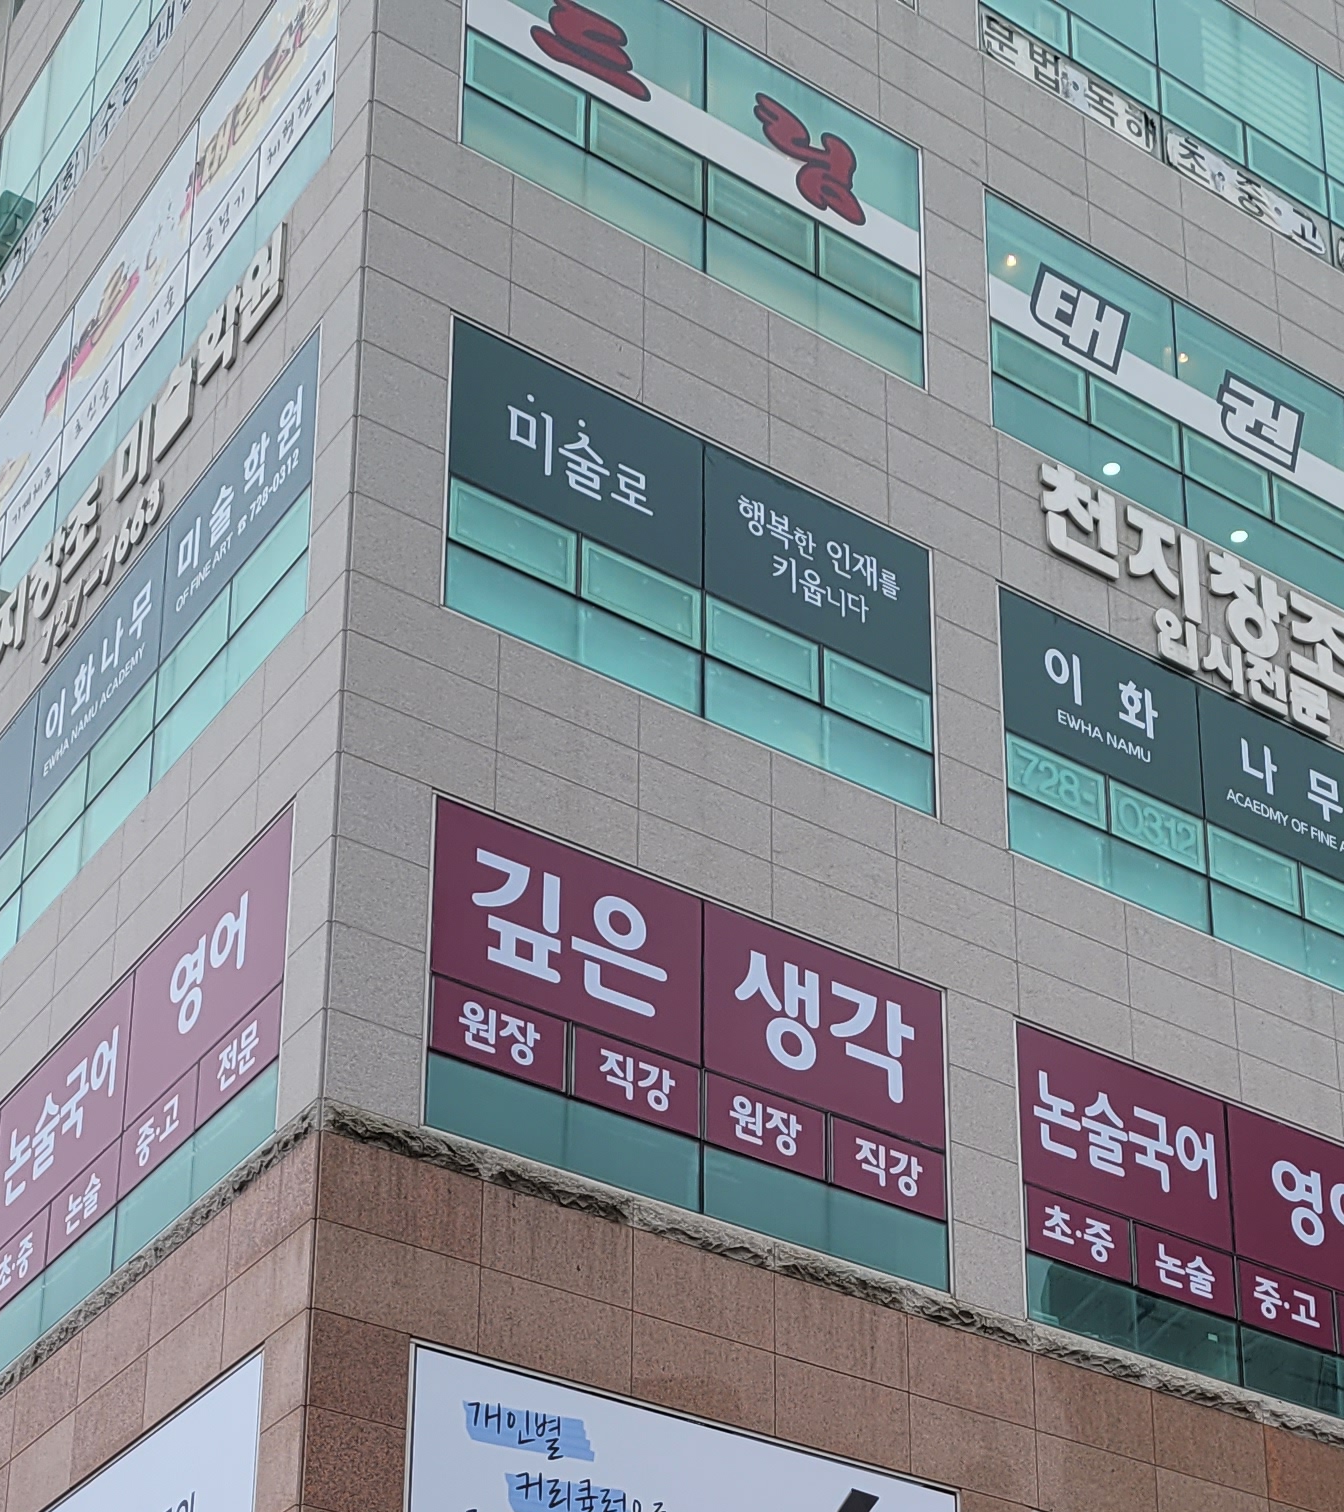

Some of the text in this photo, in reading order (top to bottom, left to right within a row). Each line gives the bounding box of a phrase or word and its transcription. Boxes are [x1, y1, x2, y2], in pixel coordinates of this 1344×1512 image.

[507, 394, 654, 517] 미술로
[248, 459, 299, 528] 728-0312
[176, 537, 232, 612] OF FINE ART
[738, 494, 900, 601] 행복한 인재를
[771, 554, 870, 623] 키웁니다
[42, 644, 145, 777] EWHA NAMU ACADEMY
[1057, 711, 1152, 764] EWHA NAMU
[1291, 817, 1309, 838] OF
[1310, 824, 1338, 851] FINE
[170, 891, 249, 1036] 영어
[471, 846, 916, 1104] 깊은 생각
[217, 1019, 260, 1092] 전문
[457, 999, 541, 1067] 원장
[598, 1047, 676, 1113] 직강
[4, 1024, 119, 1208] 논술국어
[728, 1094, 803, 1157] 원장
[1033, 1069, 1220, 1201] 논술국어
[854, 1136, 924, 1198] 직강
[64, 1171, 102, 1236] 논술
[1155, 1242, 1217, 1300] 논술
[466, 1402, 564, 1461] 개인별
